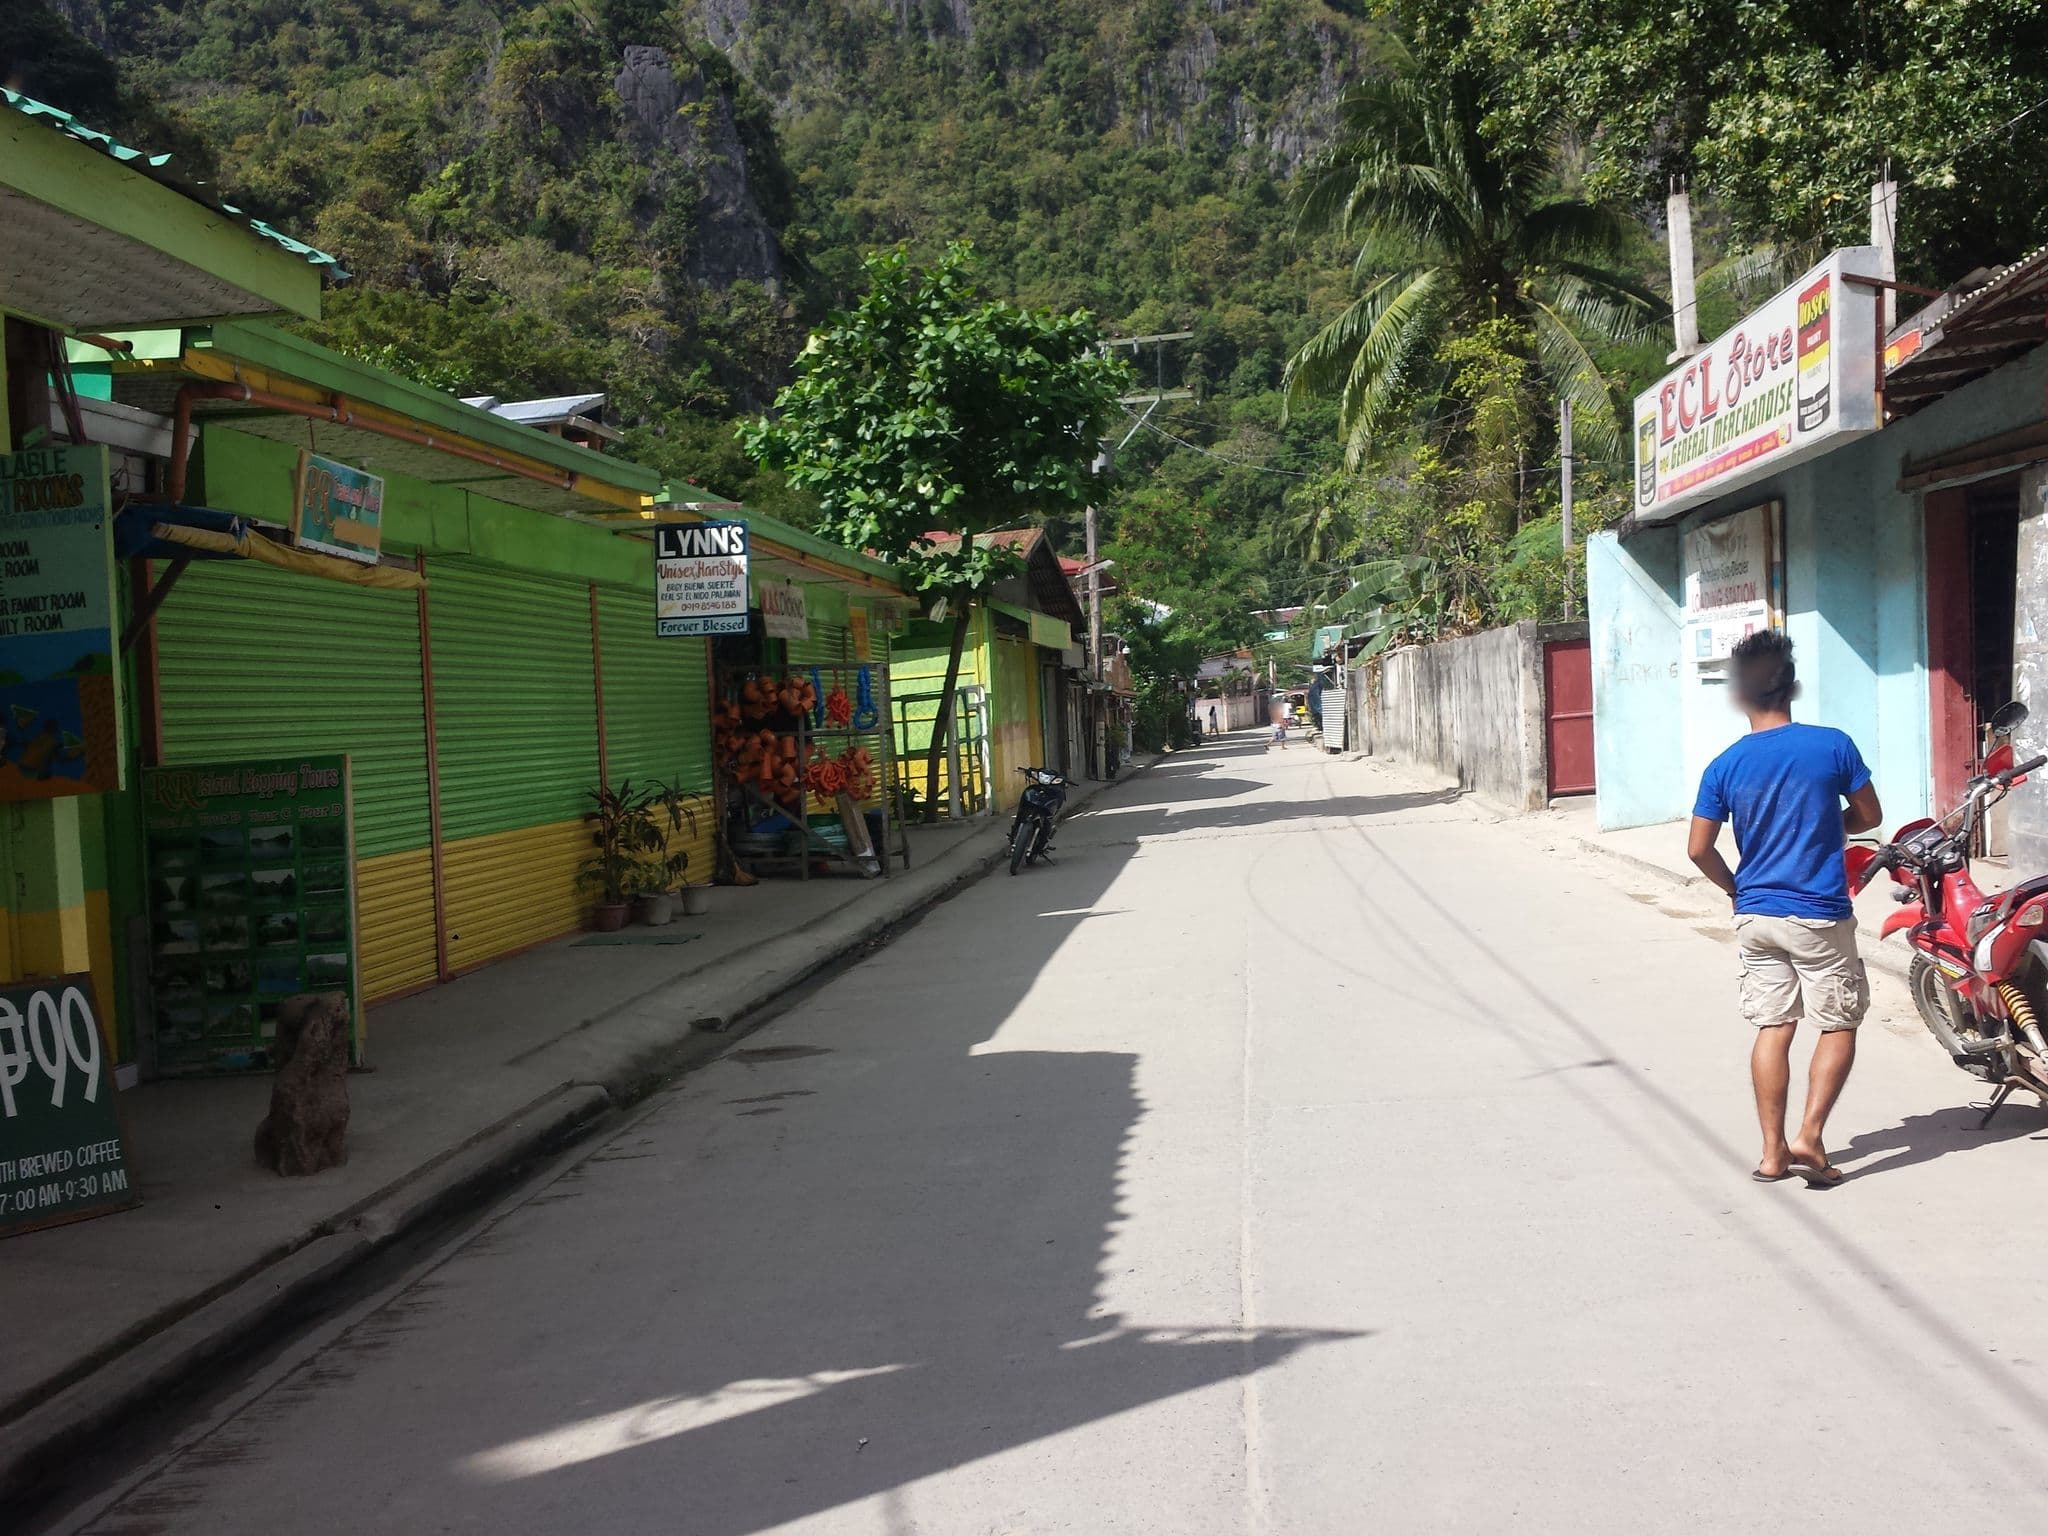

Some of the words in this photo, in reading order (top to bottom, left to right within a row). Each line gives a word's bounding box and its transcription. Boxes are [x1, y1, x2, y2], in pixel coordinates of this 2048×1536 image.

[1660, 354, 1719, 447] ECL
[1726, 326, 1793, 408] Store
[1671, 424, 1709, 470] GENERAL
[1712, 377, 1794, 450] MERCHANDISE
[14, 474, 84, 513] ROOMS
[658, 525, 744, 557] LYNN'S
[5, 560, 40, 577] ROOM
[684, 582, 705, 591] BUENA
[707, 580, 736, 590] SUERTE
[1725, 582, 1756, 607] STATION
[11, 597, 49, 615] FAMILY
[50, 592, 87, 611] ROOM
[24, 613, 63, 632] ROOM
[660, 620, 701, 634] Forever
[702, 618, 745, 632] Blessed
[299, 762, 340, 789] Tours
[19, 1150, 73, 1180] BREWED
[77, 1140, 122, 1167] COFFEE
[102, 1168, 128, 1194] AM
